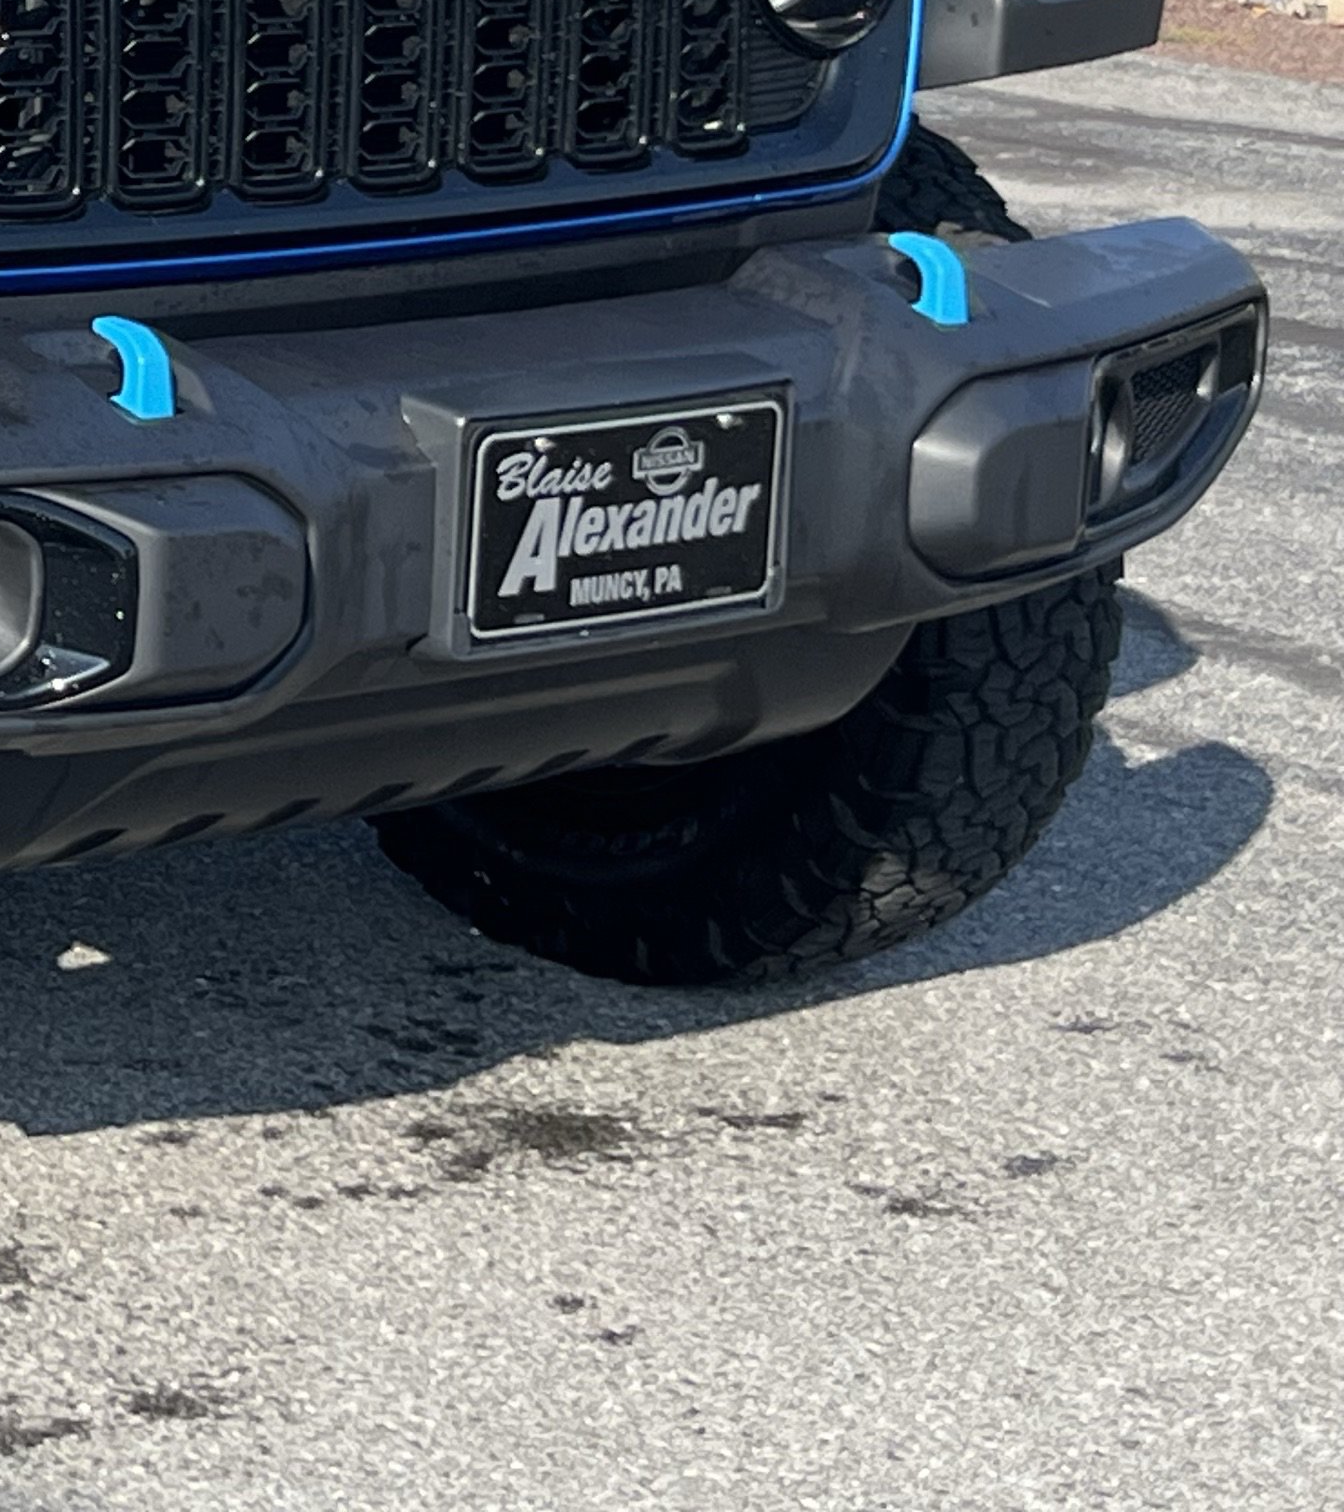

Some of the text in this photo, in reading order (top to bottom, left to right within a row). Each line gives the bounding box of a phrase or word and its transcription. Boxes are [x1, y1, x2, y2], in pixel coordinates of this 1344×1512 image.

[495, 451, 613, 502] Blaise
[497, 477, 762, 597] Alexander
[569, 564, 684, 607] MUNCY, PA
